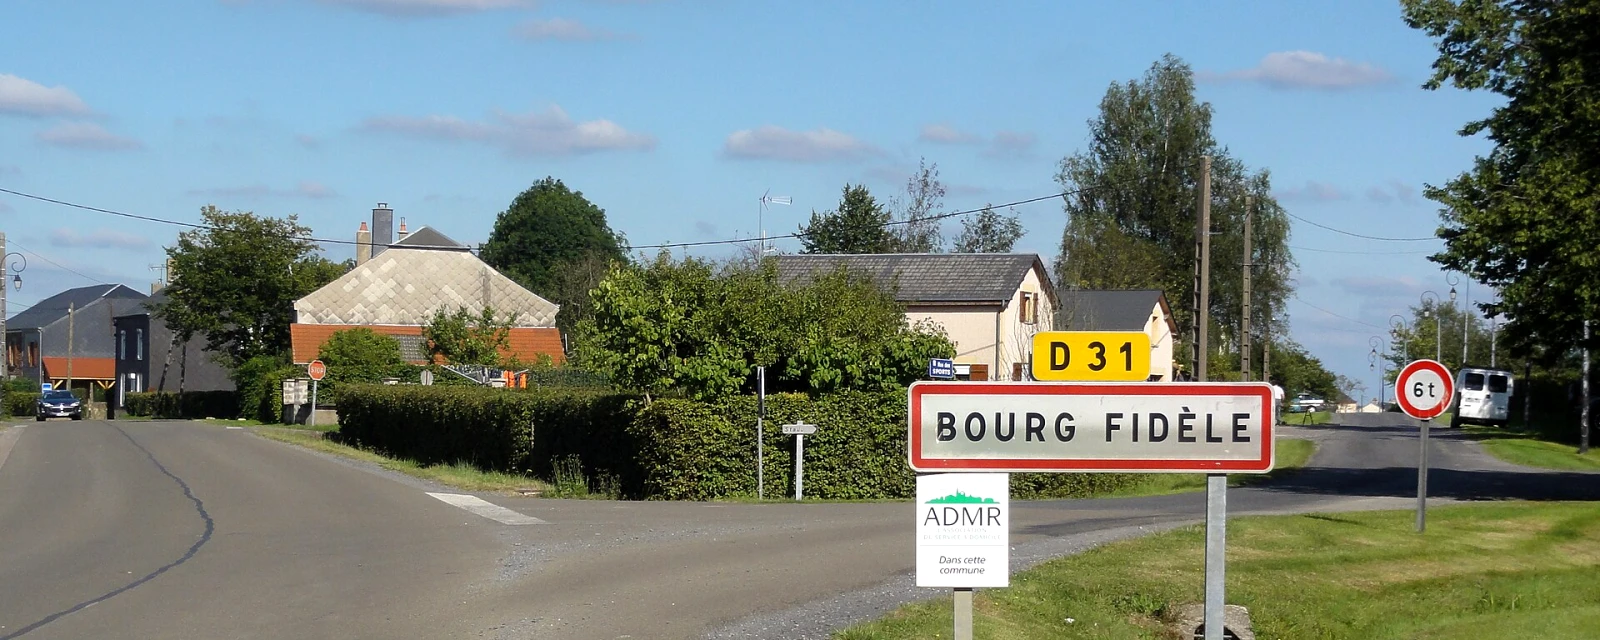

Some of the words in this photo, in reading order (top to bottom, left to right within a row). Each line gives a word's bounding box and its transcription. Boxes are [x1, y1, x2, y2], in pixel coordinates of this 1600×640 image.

[1050, 341, 1070, 371] D
[1087, 341, 1133, 371] 31
[936, 412, 1076, 442] BOURG
[1105, 406, 1251, 443] FIDÈLE
[923, 507, 1001, 526] ADMR
[939, 555, 961, 564] Dans
[963, 556, 986, 564] cette
